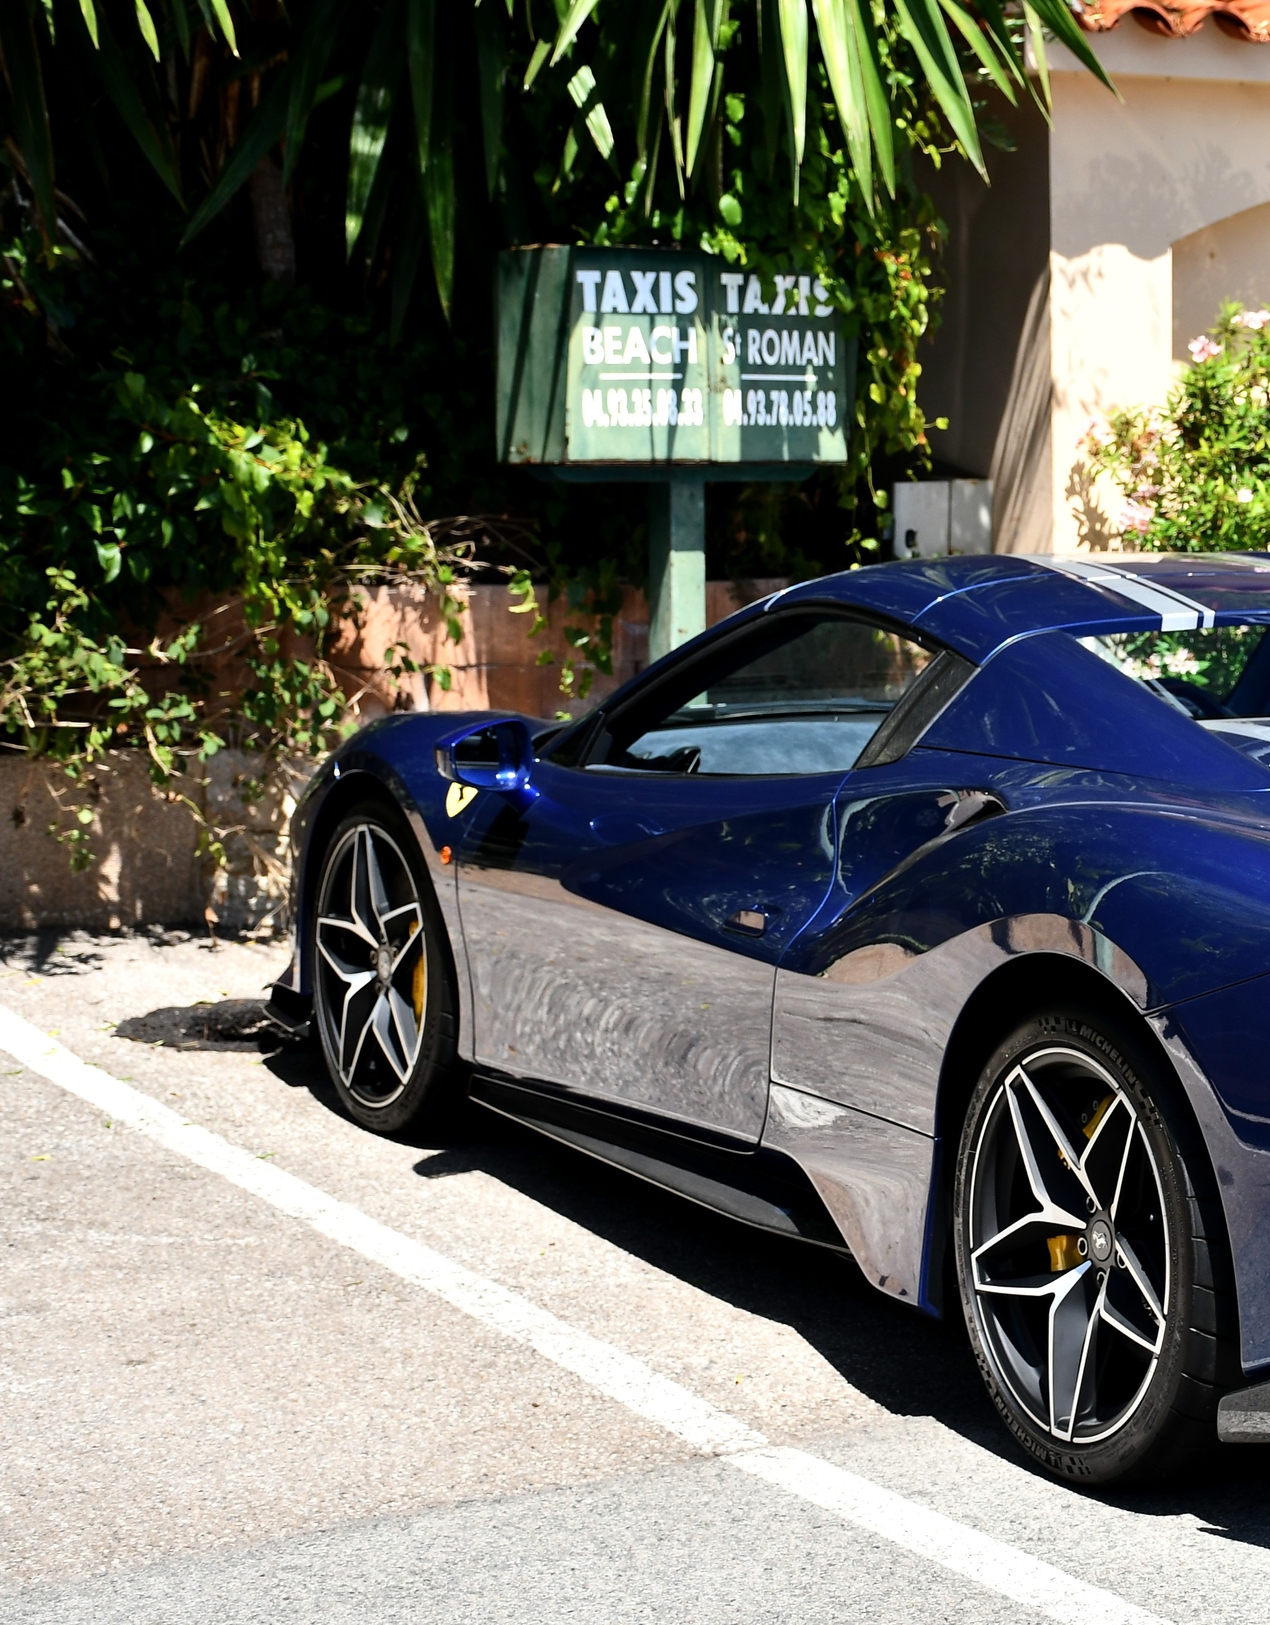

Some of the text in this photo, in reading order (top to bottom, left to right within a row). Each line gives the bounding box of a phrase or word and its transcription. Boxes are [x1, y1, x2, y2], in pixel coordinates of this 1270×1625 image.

[576, 270, 698, 314] TAXIS
[720, 272, 835, 317] TAXIS
[582, 326, 697, 365] BEACH
[722, 327, 836, 367] St ROMAN
[1079, 1024, 1137, 1084] MICHELIN
[995, 1395, 1048, 1460] MICHELIN
